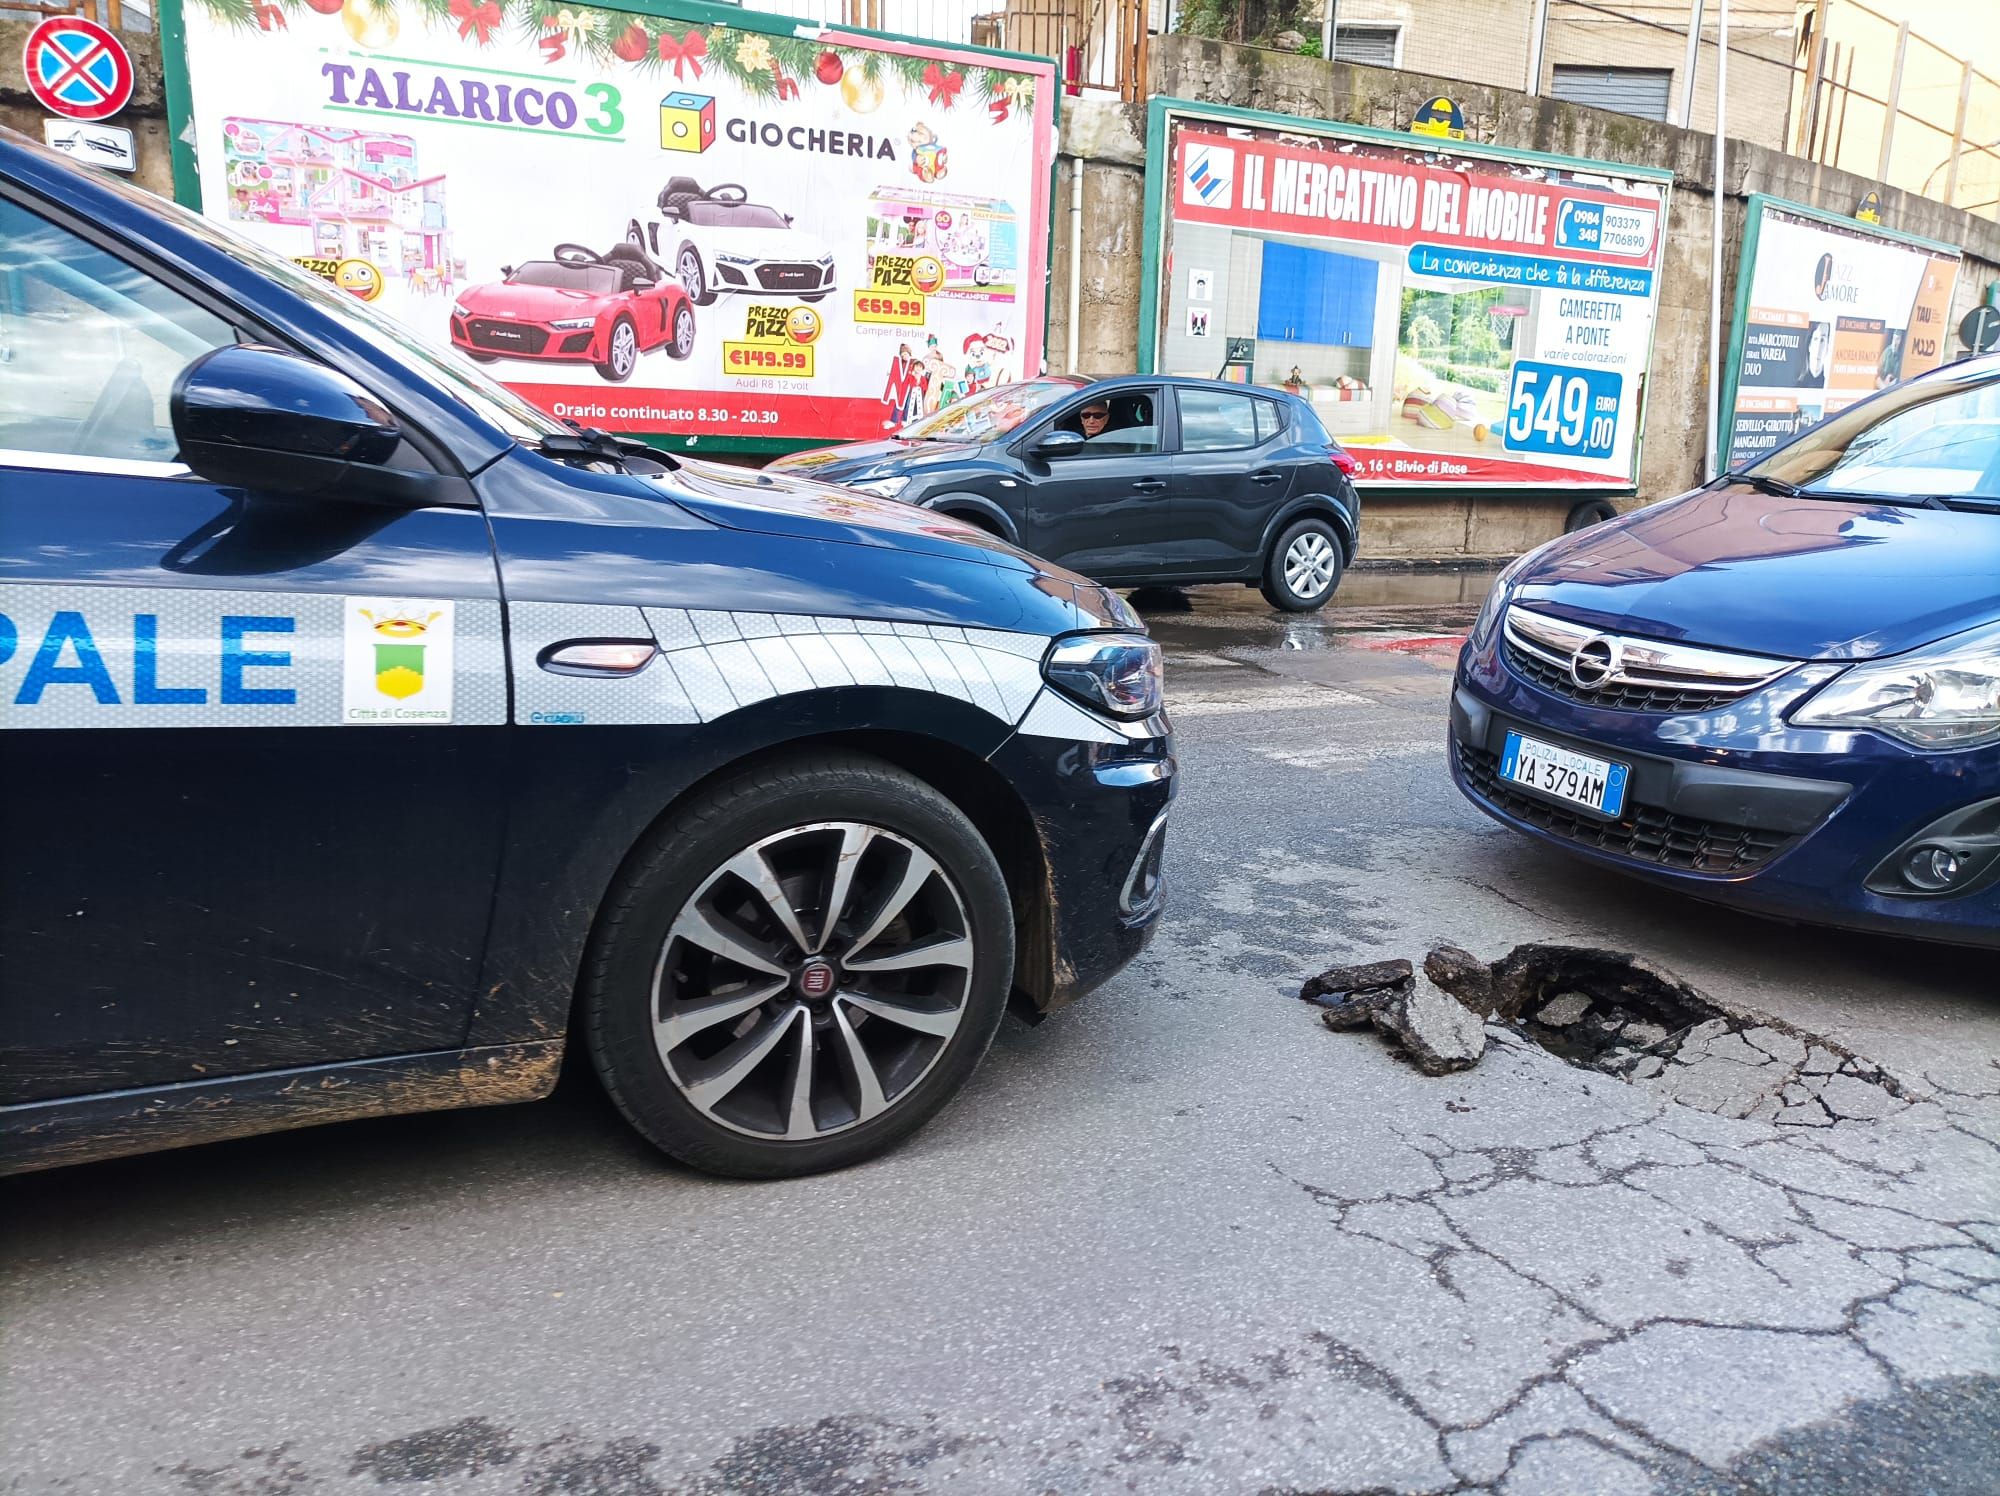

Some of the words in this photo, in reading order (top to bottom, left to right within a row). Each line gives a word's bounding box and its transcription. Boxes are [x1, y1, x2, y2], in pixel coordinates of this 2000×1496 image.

[321, 62, 578, 130] TALARICO
[584, 82, 625, 135] 3
[726, 118, 896, 161] GIOCHERIA
[1241, 153, 1265, 211] IL
[1272, 157, 1417, 230] MERCATINO
[1421, 180, 1461, 236] DEL
[1465, 186, 1549, 245] MOBILE
[1574, 210, 1600, 225] 0984
[1605, 215, 1641, 230] 903379
[1579, 228, 1598, 242] 348
[1604, 232, 1645, 248] 7706890
[875, 256, 914, 268] PREZZO
[1421, 250, 1439, 271] La
[1443, 257, 1521, 281] convenienza
[1526, 261, 1550, 281] che
[1556, 269, 1567, 284] fa
[1571, 270, 1581, 285] la
[1585, 269, 1647, 292] differenza
[748, 306, 789, 319] PREZZO
[857, 298, 921, 317] €69.99
[1559, 298, 1622, 323] CAMERETTA
[1916, 306, 1932, 323] TAU
[856, 325, 893, 337] Camper
[895, 328, 925, 339] Barbie
[1565, 325, 1574, 344] A
[1576, 326, 1611, 347] PONTE
[1758, 333, 1800, 348] MARCOTULLI
[729, 350, 806, 368] €149.99
[1544, 349, 1570, 360] varie
[1572, 351, 1627, 364] colorazioni
[1744, 363, 1762, 376] DUO
[735, 379, 758, 388] Audi
[762, 380, 774, 388] R8
[778, 381, 789, 389] 12
[791, 382, 808, 390] volt
[553, 402, 606, 417] Orario
[610, 405, 695, 421] continuato
[698, 408, 728, 422] 8.30
[741, 410, 779, 424] 20.30
[1595, 396, 1617, 412] EURO
[1369, 460, 1383, 472] 16
[1395, 461, 1424, 473] Bivio
[1428, 460, 1438, 474] di
[1441, 462, 1468, 475] Rose
[0, 611, 296, 704] ALE
[381, 707, 392, 719] di
[394, 708, 448, 719] Cosenza
[1525, 742, 1557, 762] POLIZIA
[1564, 755, 1601, 776] LOCALE
[1518, 753, 1536, 785] YA
